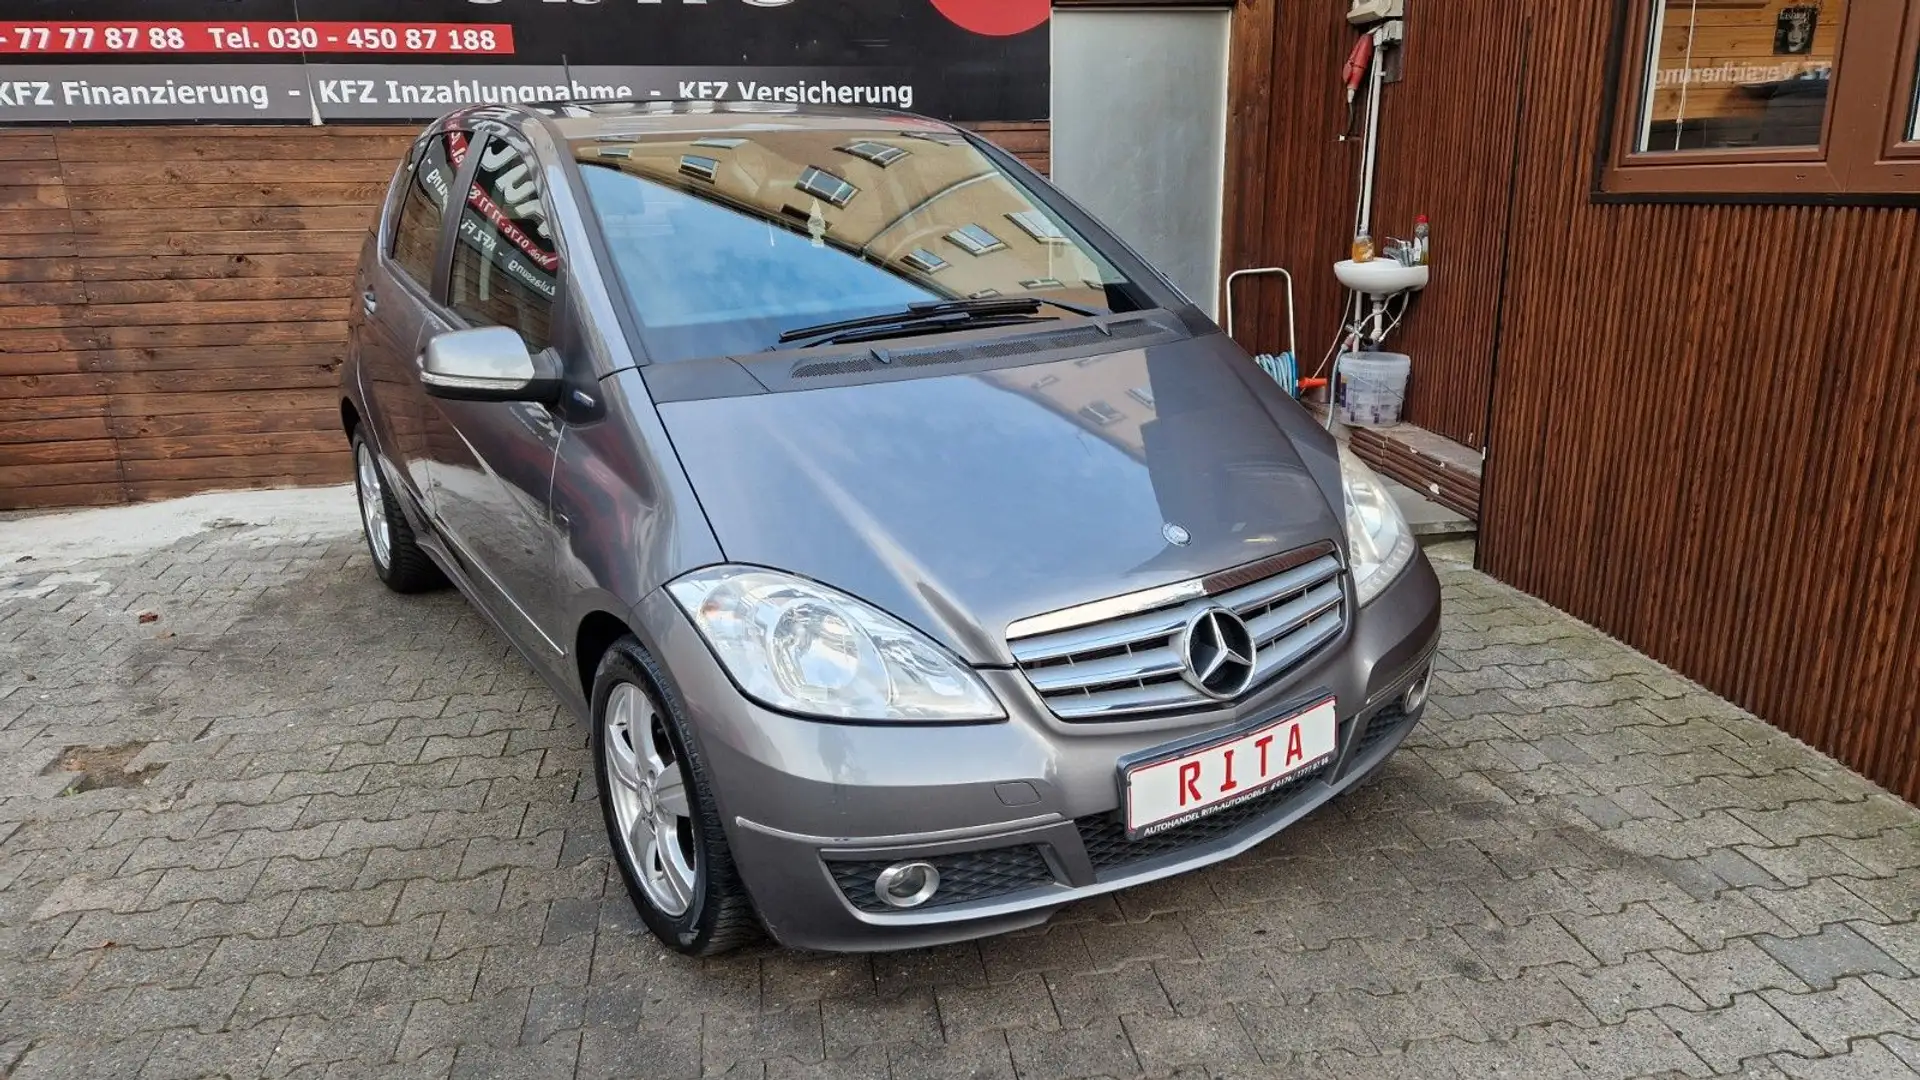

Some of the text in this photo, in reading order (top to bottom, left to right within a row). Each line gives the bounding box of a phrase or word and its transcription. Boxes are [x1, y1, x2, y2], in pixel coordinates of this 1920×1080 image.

[14, 27, 50, 49] 77
[59, 27, 95, 49] 77
[104, 27, 139, 49] 87
[149, 27, 185, 49] 88
[207, 27, 260, 49] Tel.
[267, 27, 319, 49] 030
[347, 28, 397, 49] 450
[405, 28, 437, 49] 87
[448, 29, 496, 50] 188
[61, 79, 269, 110] Finanzierung
[318, 79, 378, 104] KFZ
[385, 79, 633, 104] Inzahlungnahme
[737, 80, 913, 108] Versicherung
[1179, 722, 1303, 806] RITA
[1143, 811, 1200, 837] AUTOHANDEL
[1201, 787, 1267, 817] RITA-AUTOMOBILE
